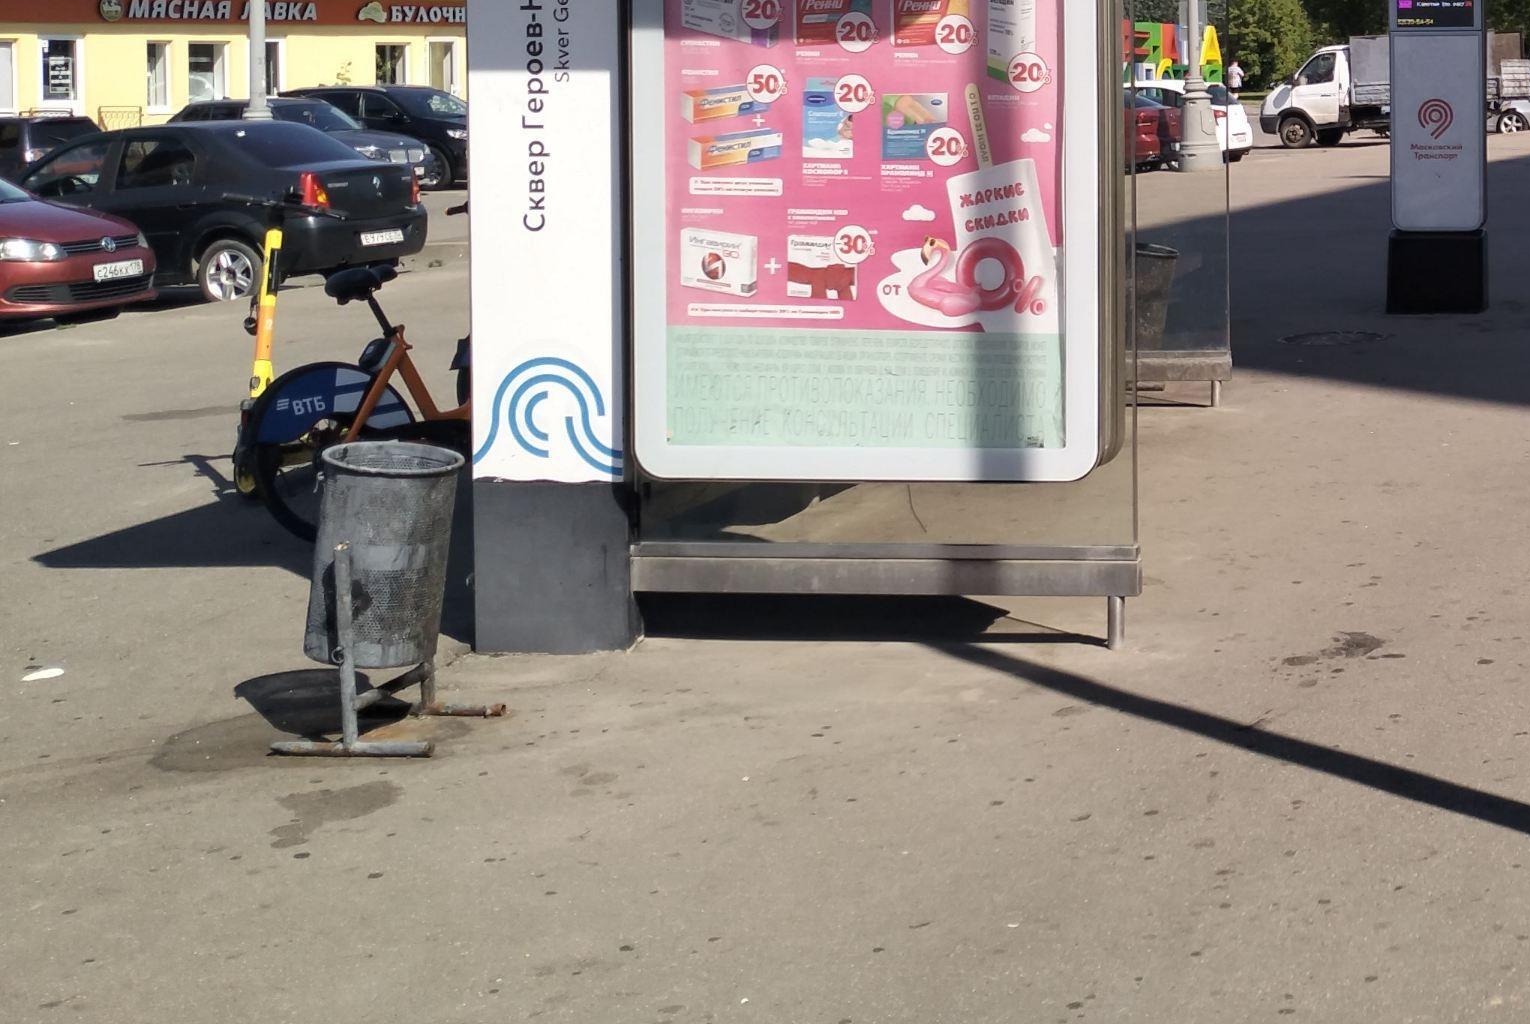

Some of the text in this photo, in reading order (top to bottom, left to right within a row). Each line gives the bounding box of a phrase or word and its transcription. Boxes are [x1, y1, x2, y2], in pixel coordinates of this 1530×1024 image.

[806, 0, 843, 10] Ренни
[904, 0, 941, 11] Ренни
[553, 32, 570, 83] Skver
[523, 140, 550, 232] Сквер
[960, 182, 1025, 208] ЖАРКИЕ
[965, 207, 1030, 233] СКИДКИ
[292, 396, 326, 415] ВТБ
